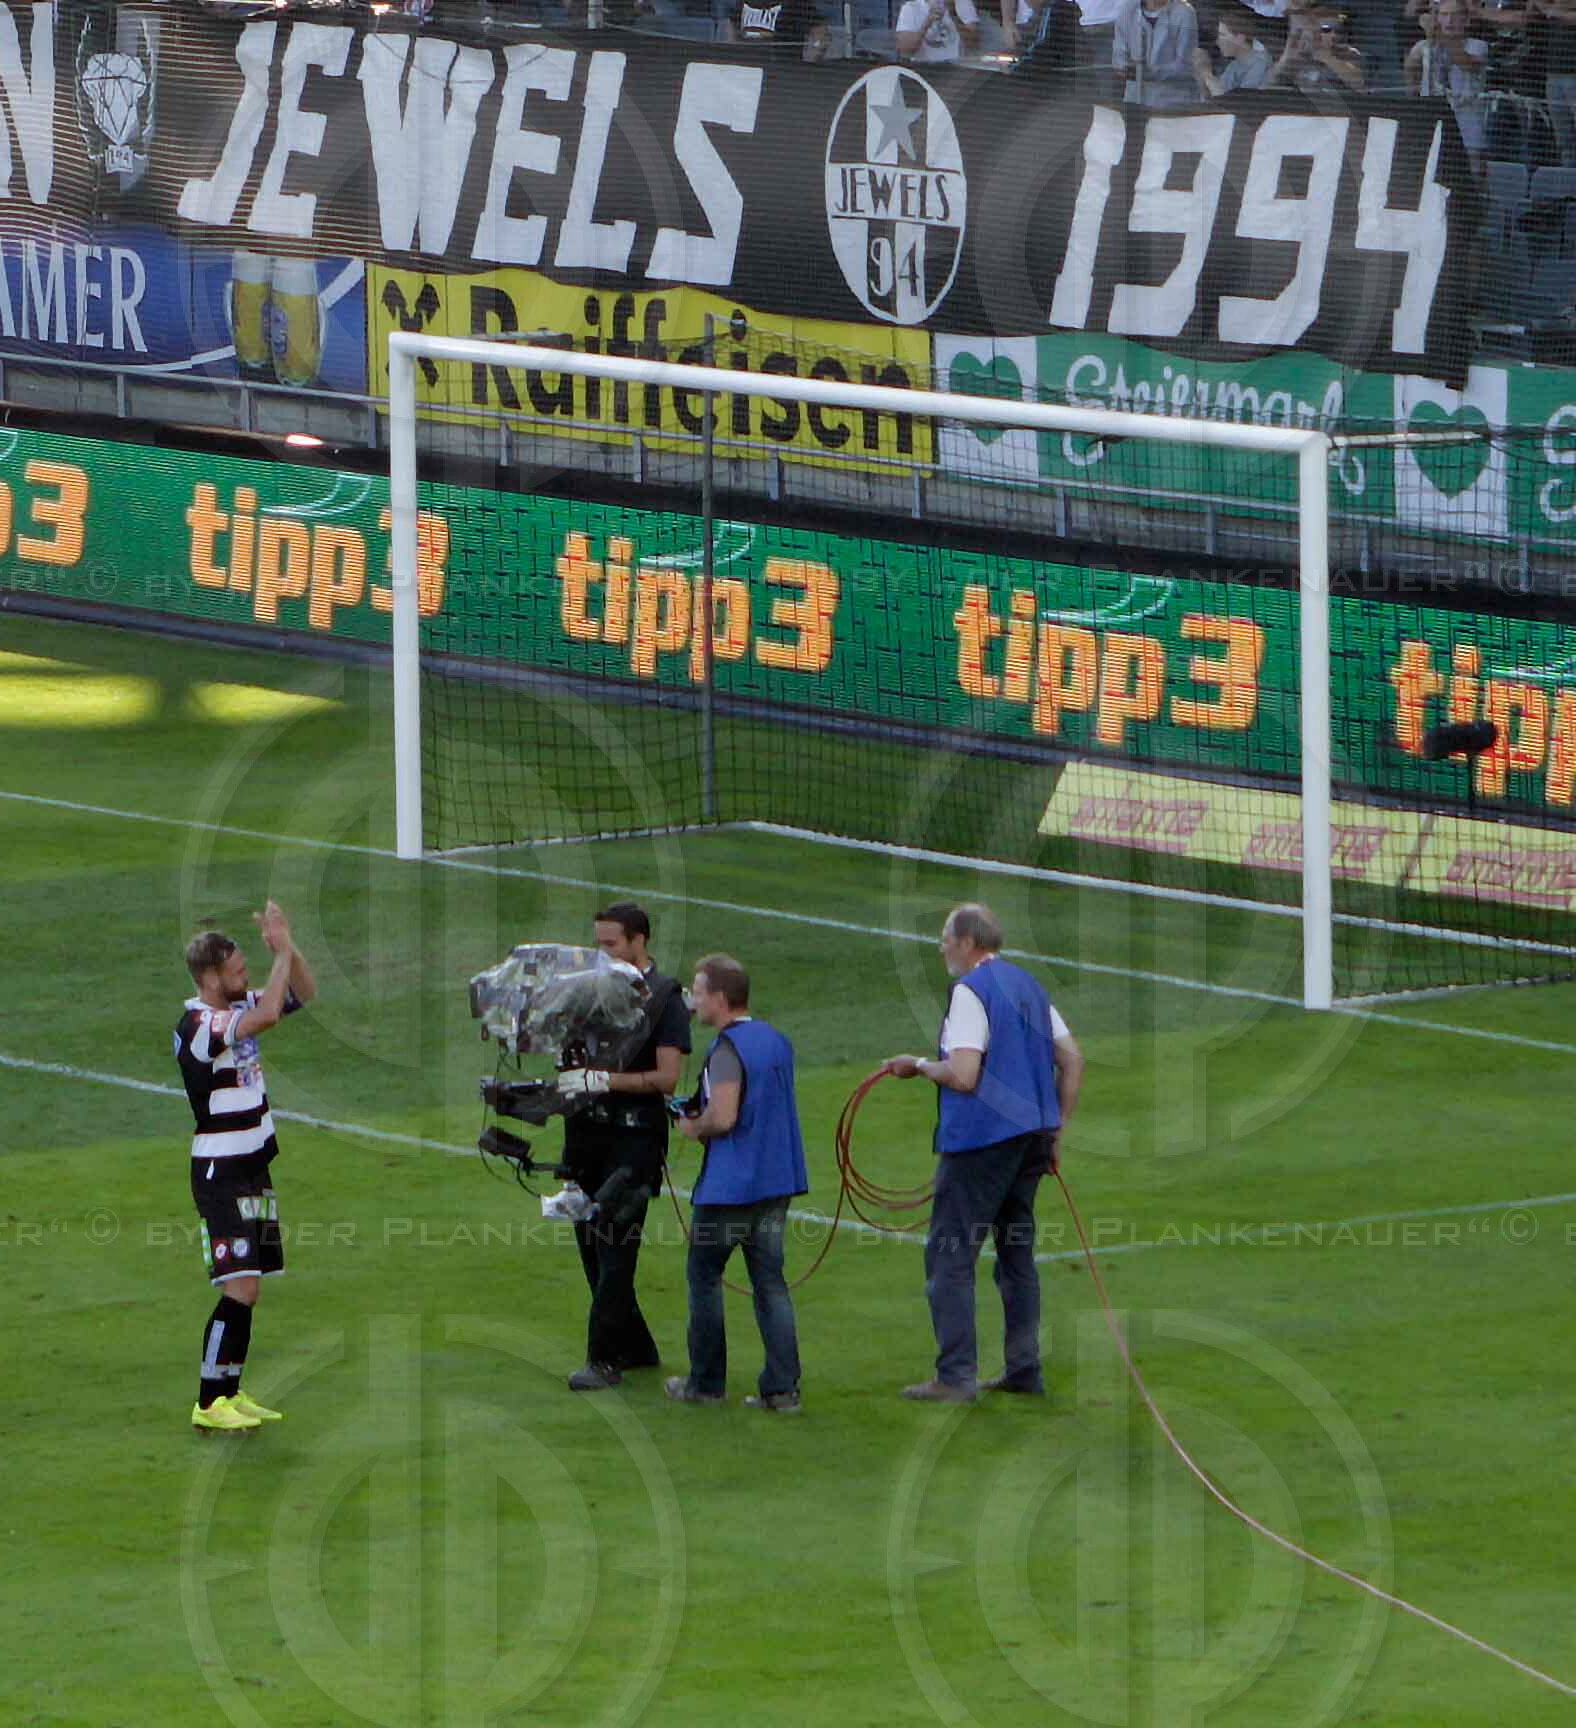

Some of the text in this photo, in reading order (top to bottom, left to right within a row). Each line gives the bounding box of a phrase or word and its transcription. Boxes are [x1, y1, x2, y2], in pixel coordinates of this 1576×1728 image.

[176, 20, 764, 286] JEWELS
[1048, 104, 1451, 354] 1994
[834, 166, 950, 221] JEWELS
[868, 234, 921, 298] 94
[186, 482, 451, 628] tipp3
[556, 531, 840, 681] tipp3
[952, 585, 1265, 745] tipp3
